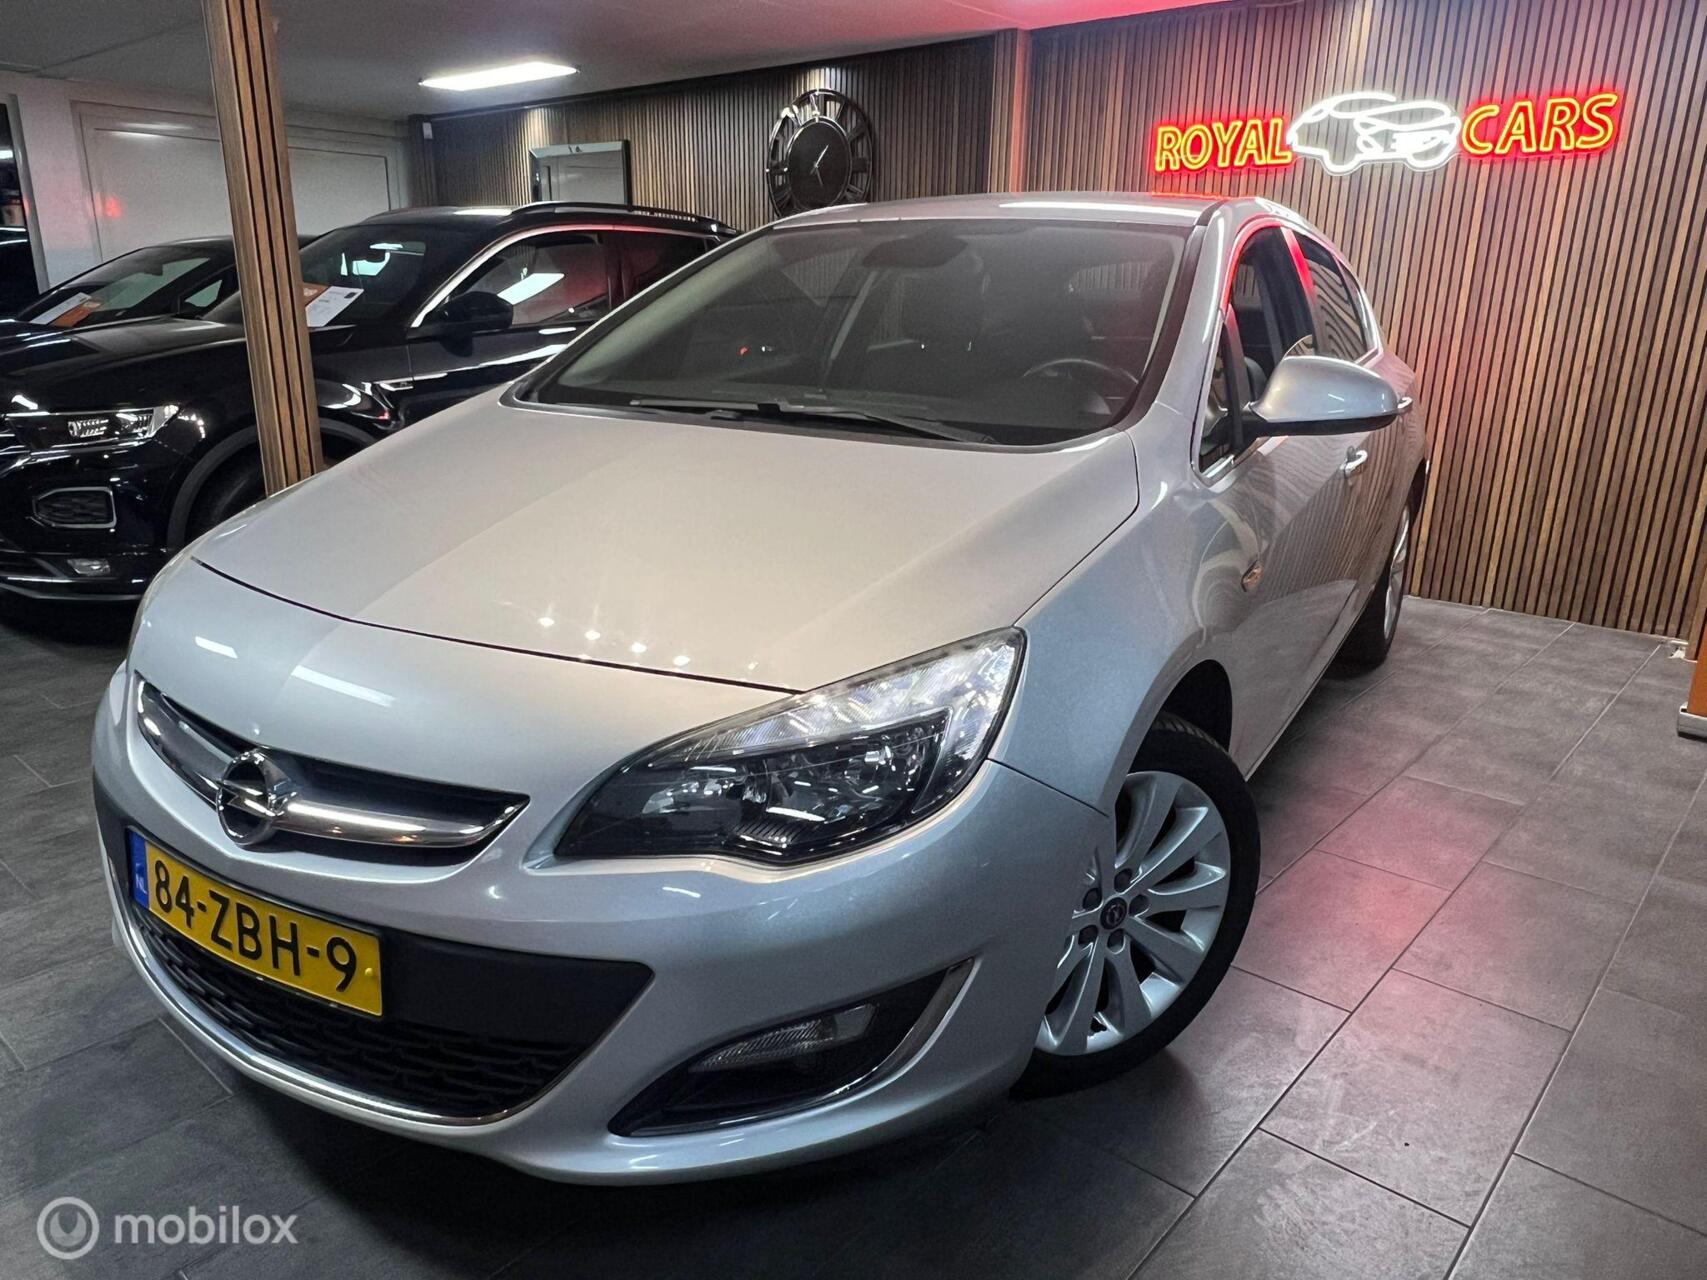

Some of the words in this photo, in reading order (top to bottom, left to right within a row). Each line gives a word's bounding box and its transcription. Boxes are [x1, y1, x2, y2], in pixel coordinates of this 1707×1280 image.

[1154, 118, 1293, 172] ROYAL
[1461, 92, 1619, 155] CARS
[154, 859, 358, 993] 84-ZBH-9
